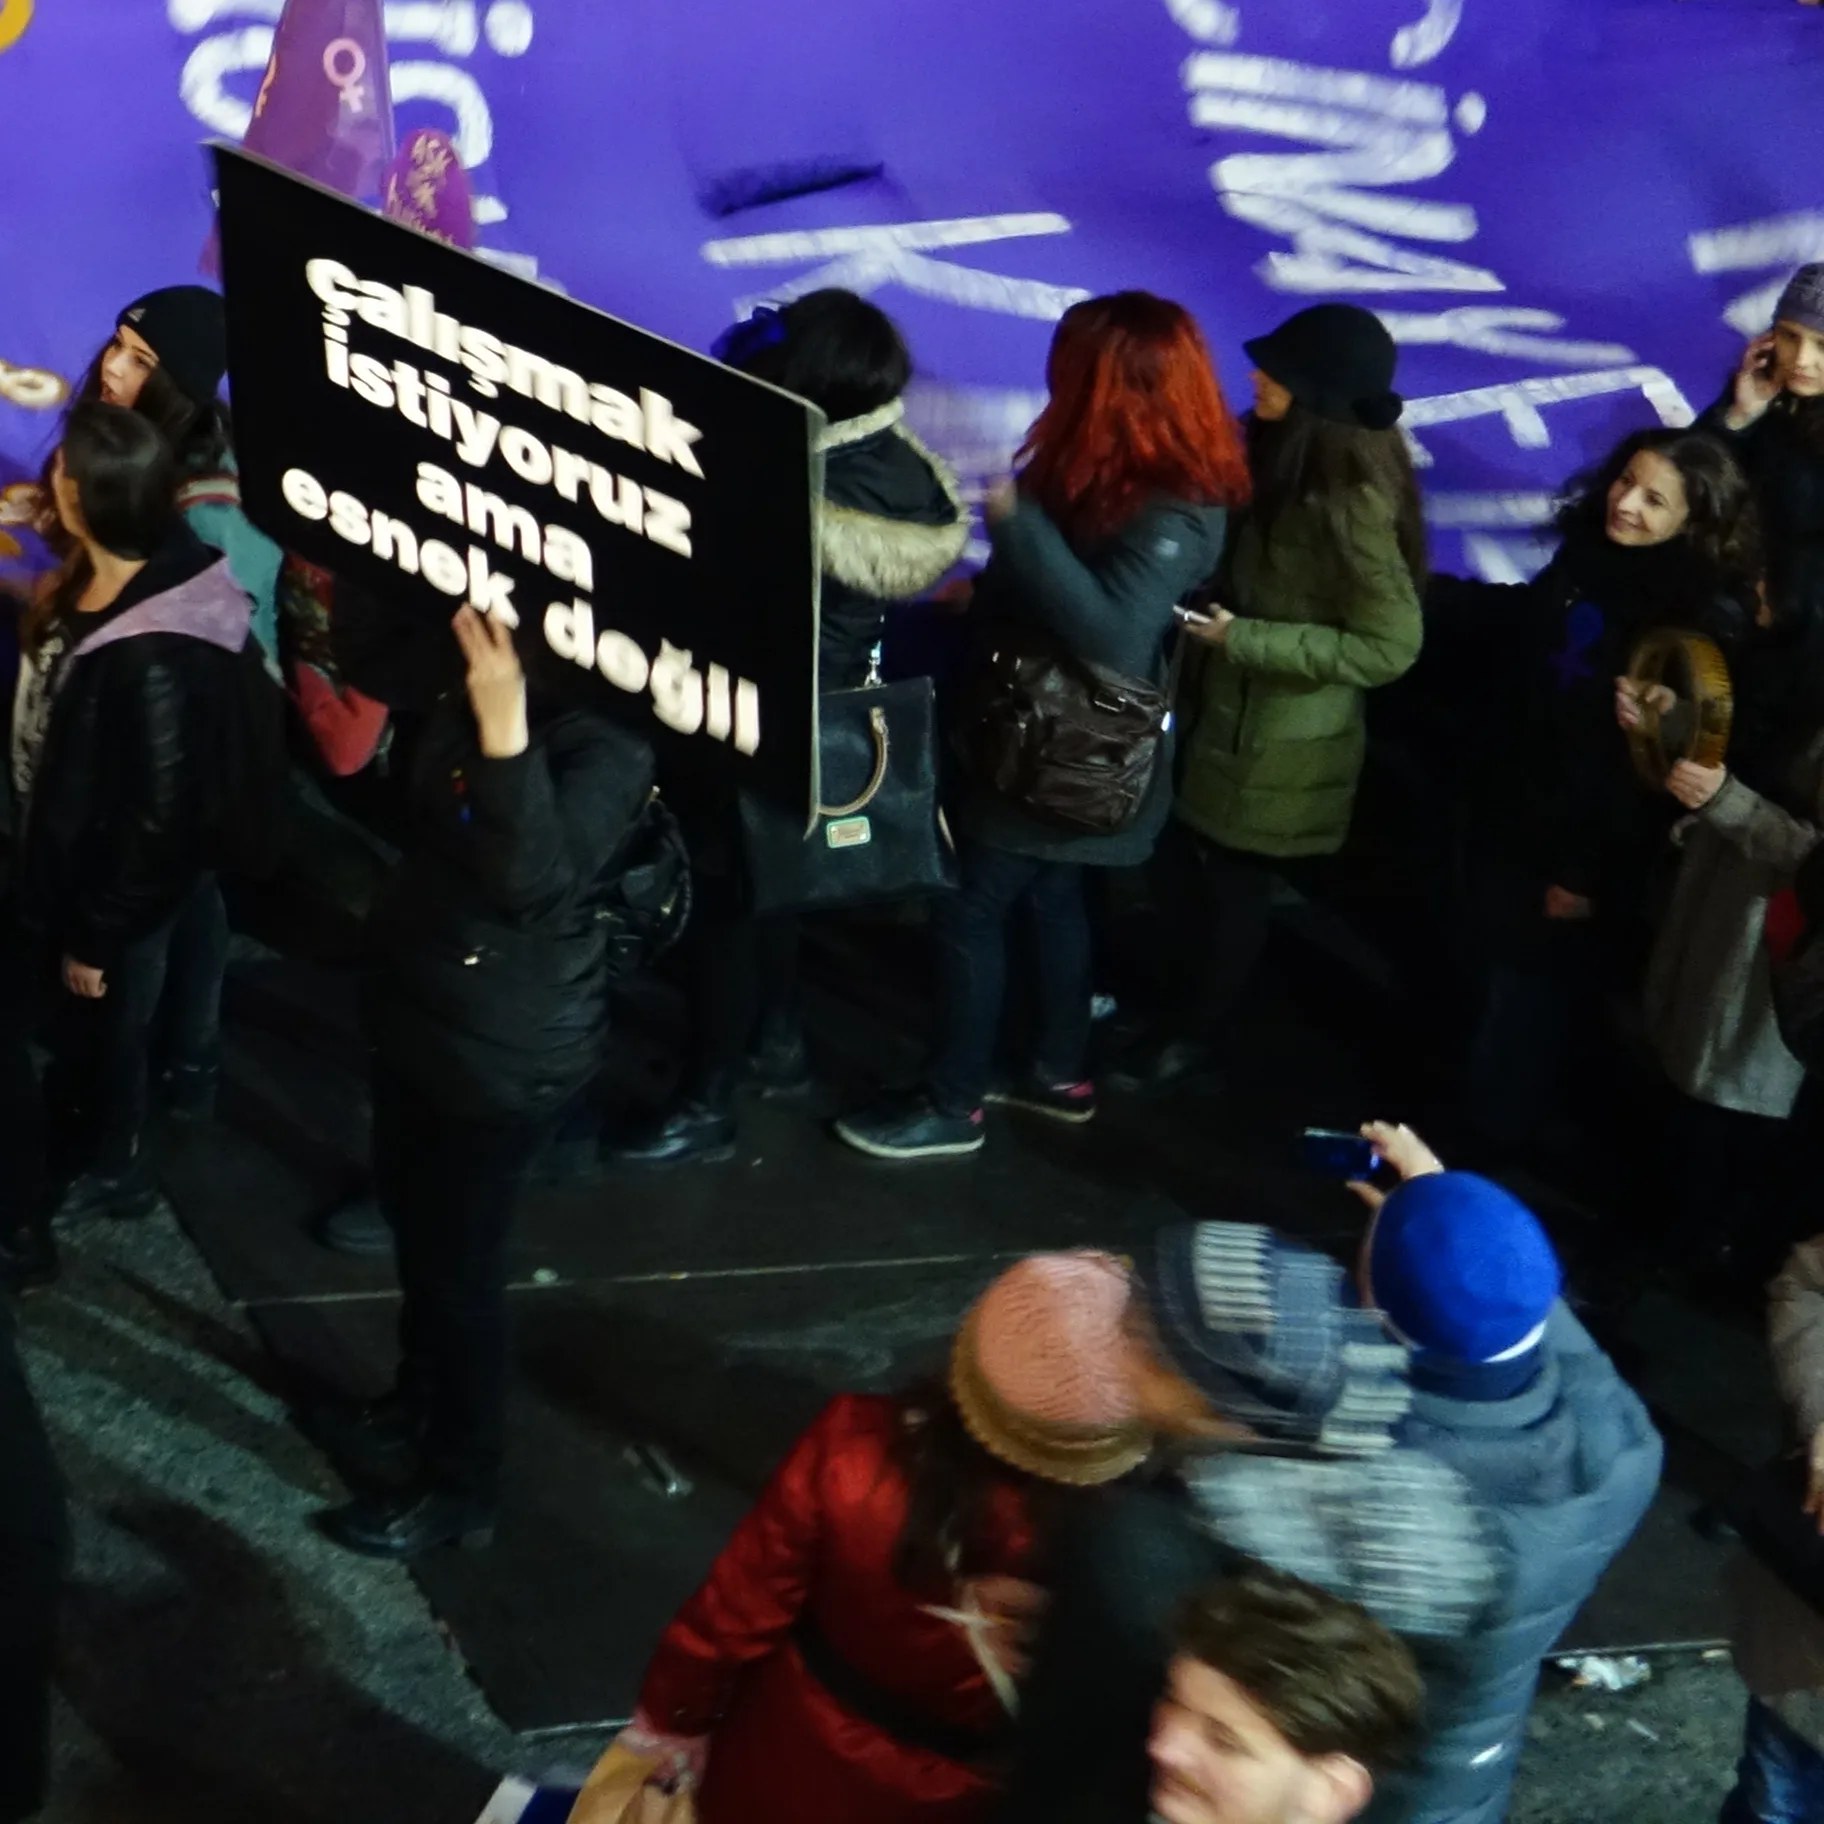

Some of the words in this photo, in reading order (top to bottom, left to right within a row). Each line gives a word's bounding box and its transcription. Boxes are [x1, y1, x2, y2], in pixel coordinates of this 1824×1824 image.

[305, 257, 706, 479] çalışmak
[322, 323, 693, 559] istiyoruz
[281, 466, 520, 629] esnek
[544, 600, 761, 757] değil
[416, 460, 595, 594] ama
